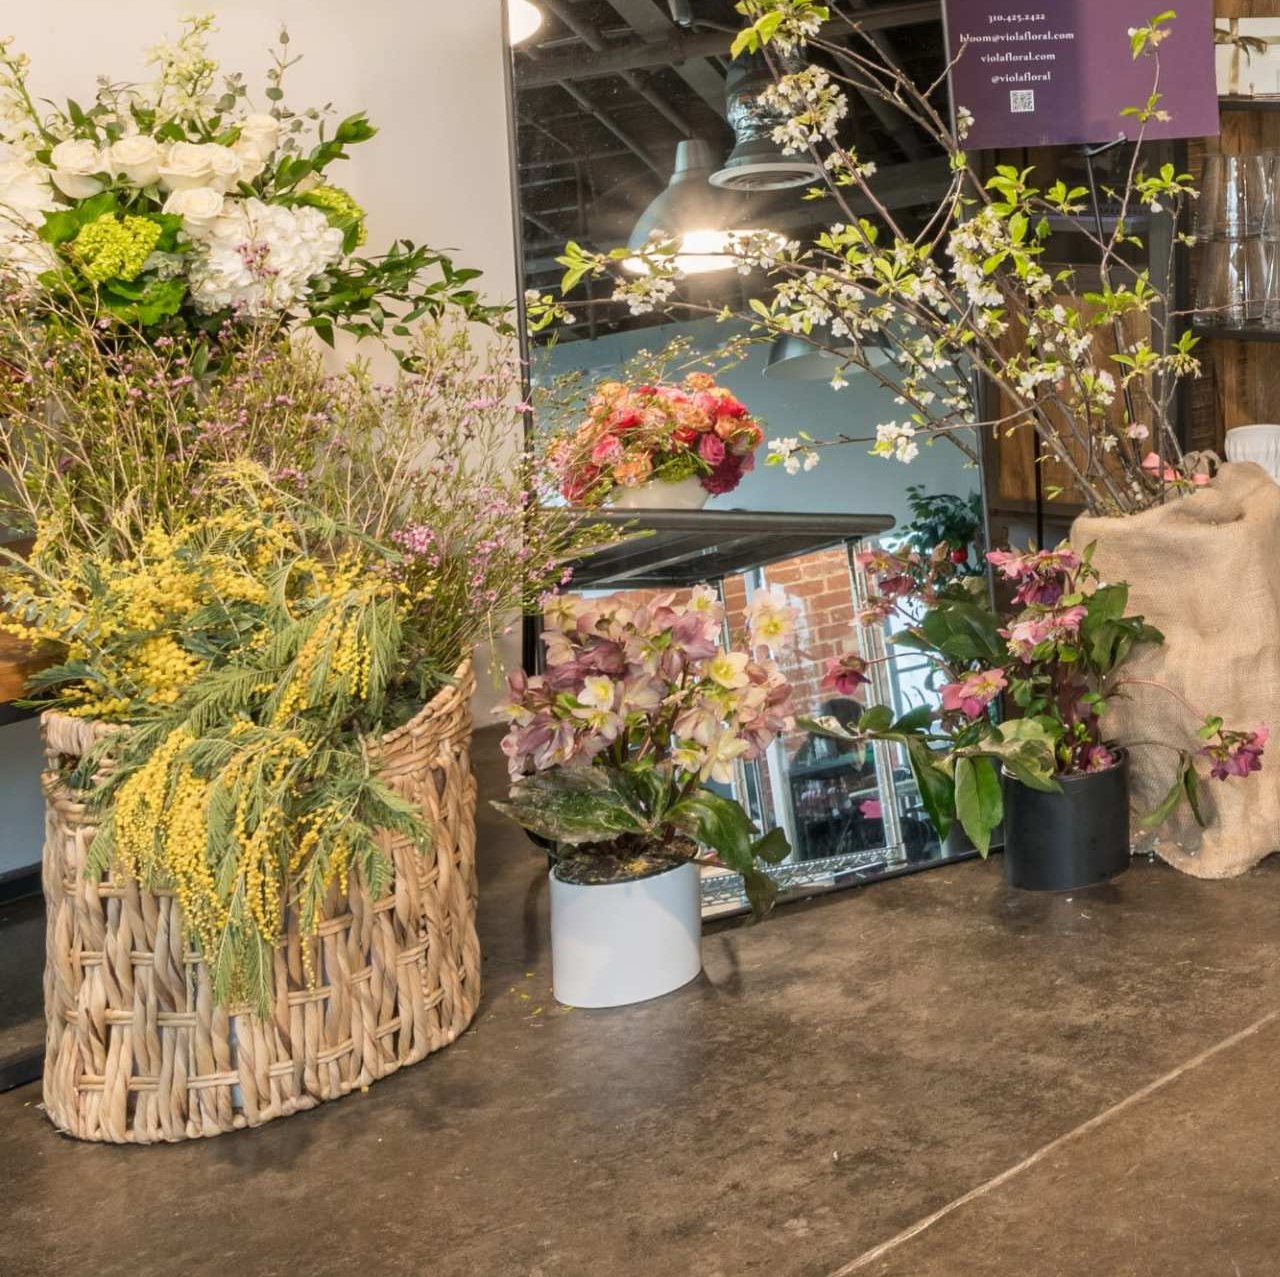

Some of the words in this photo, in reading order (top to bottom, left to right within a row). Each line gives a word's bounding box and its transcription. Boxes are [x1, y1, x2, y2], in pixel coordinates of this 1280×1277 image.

[989, 13, 1045, 24] 310.425.2422
[959, 31, 1074, 43] bloom@violafloral.com
[980, 52, 1056, 63] violafloral.com
[991, 71, 1051, 84] @violafloral
